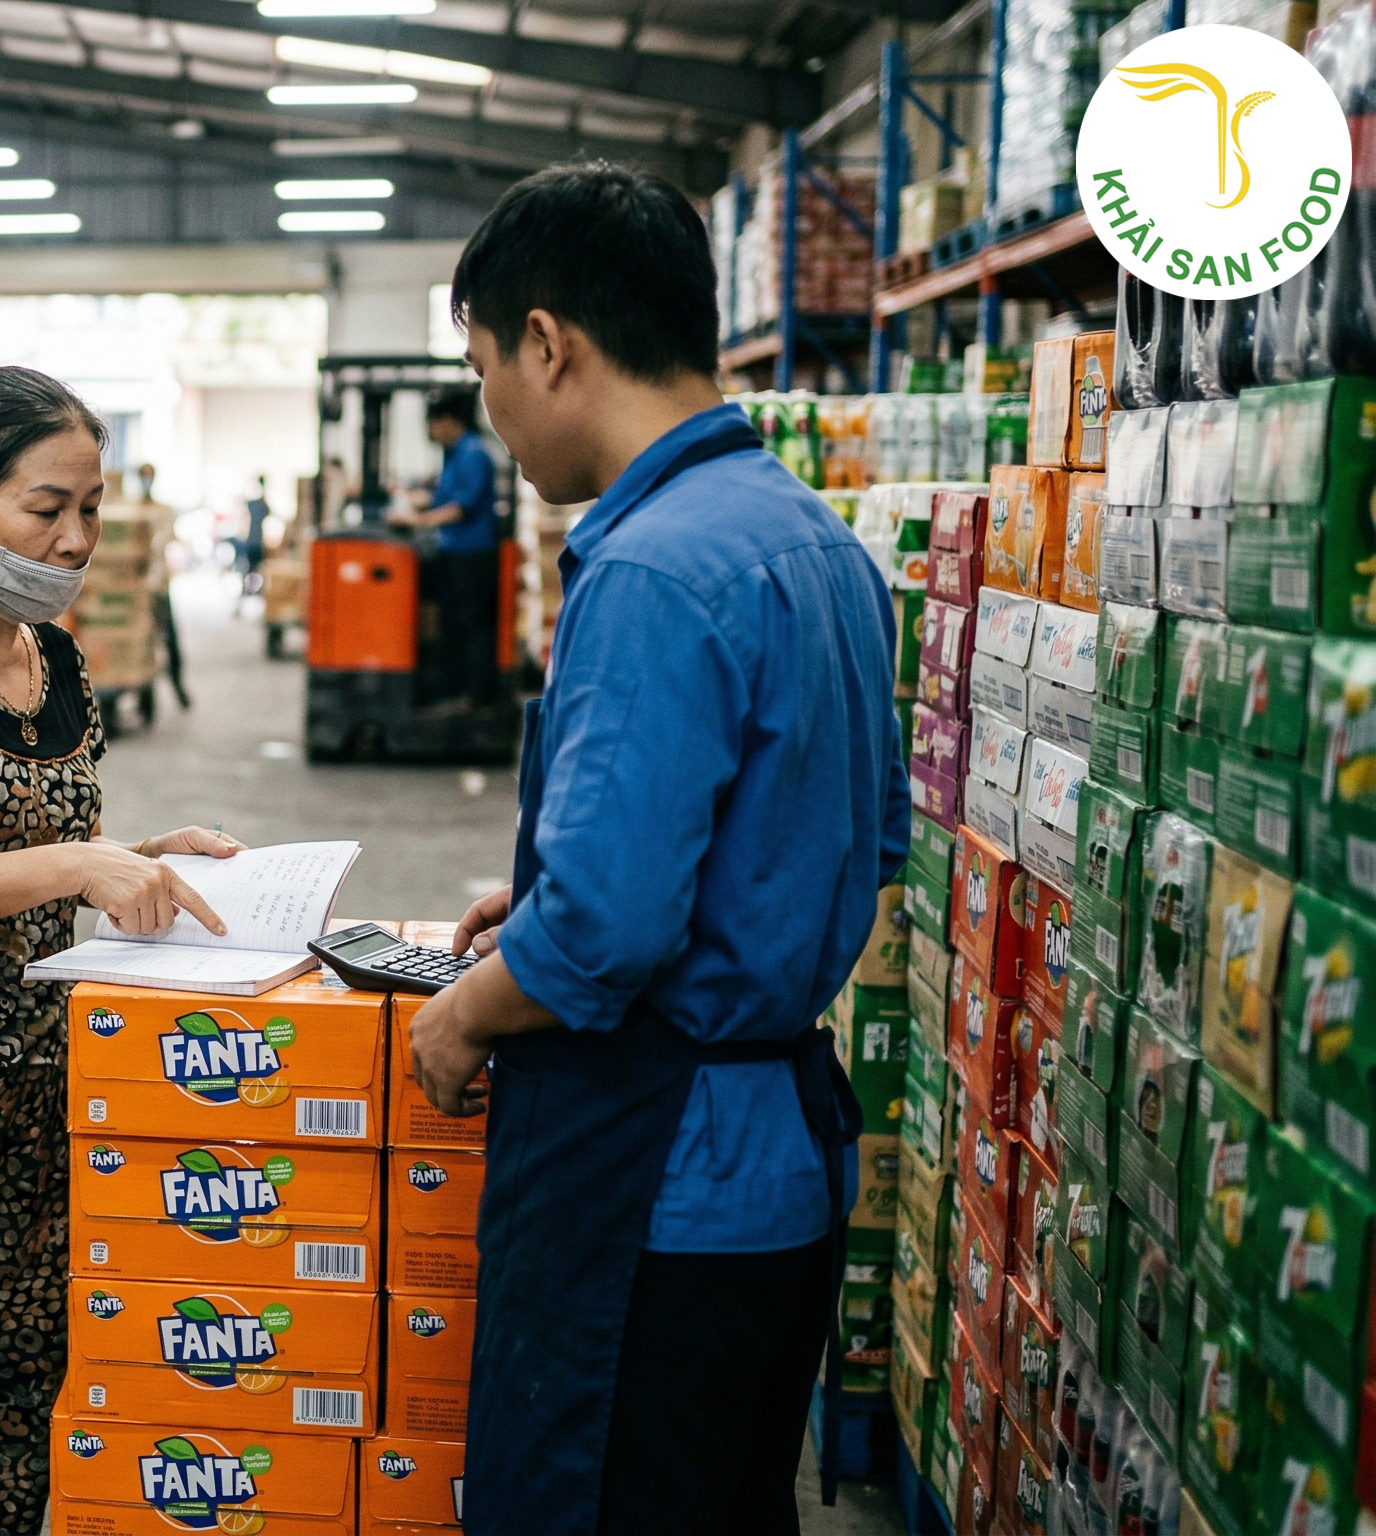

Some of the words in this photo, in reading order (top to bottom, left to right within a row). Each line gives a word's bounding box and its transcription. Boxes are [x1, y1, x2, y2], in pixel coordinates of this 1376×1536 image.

[1045, 917, 1071, 969] FANT
[87, 1014, 126, 1029] FANTA
[161, 1031, 280, 1077] FANTA
[88, 1151, 125, 1166] FANTA
[408, 1168, 448, 1184] FANTA
[162, 1169, 279, 1215] FANTA
[87, 1296, 125, 1311] FANTA
[407, 1315, 447, 1330] FANTA
[160, 1317, 275, 1360] FANTA
[67, 1435, 105, 1450] FANTA
[379, 1457, 417, 1472] FANTA
[141, 1457, 255, 1499] FANTA
